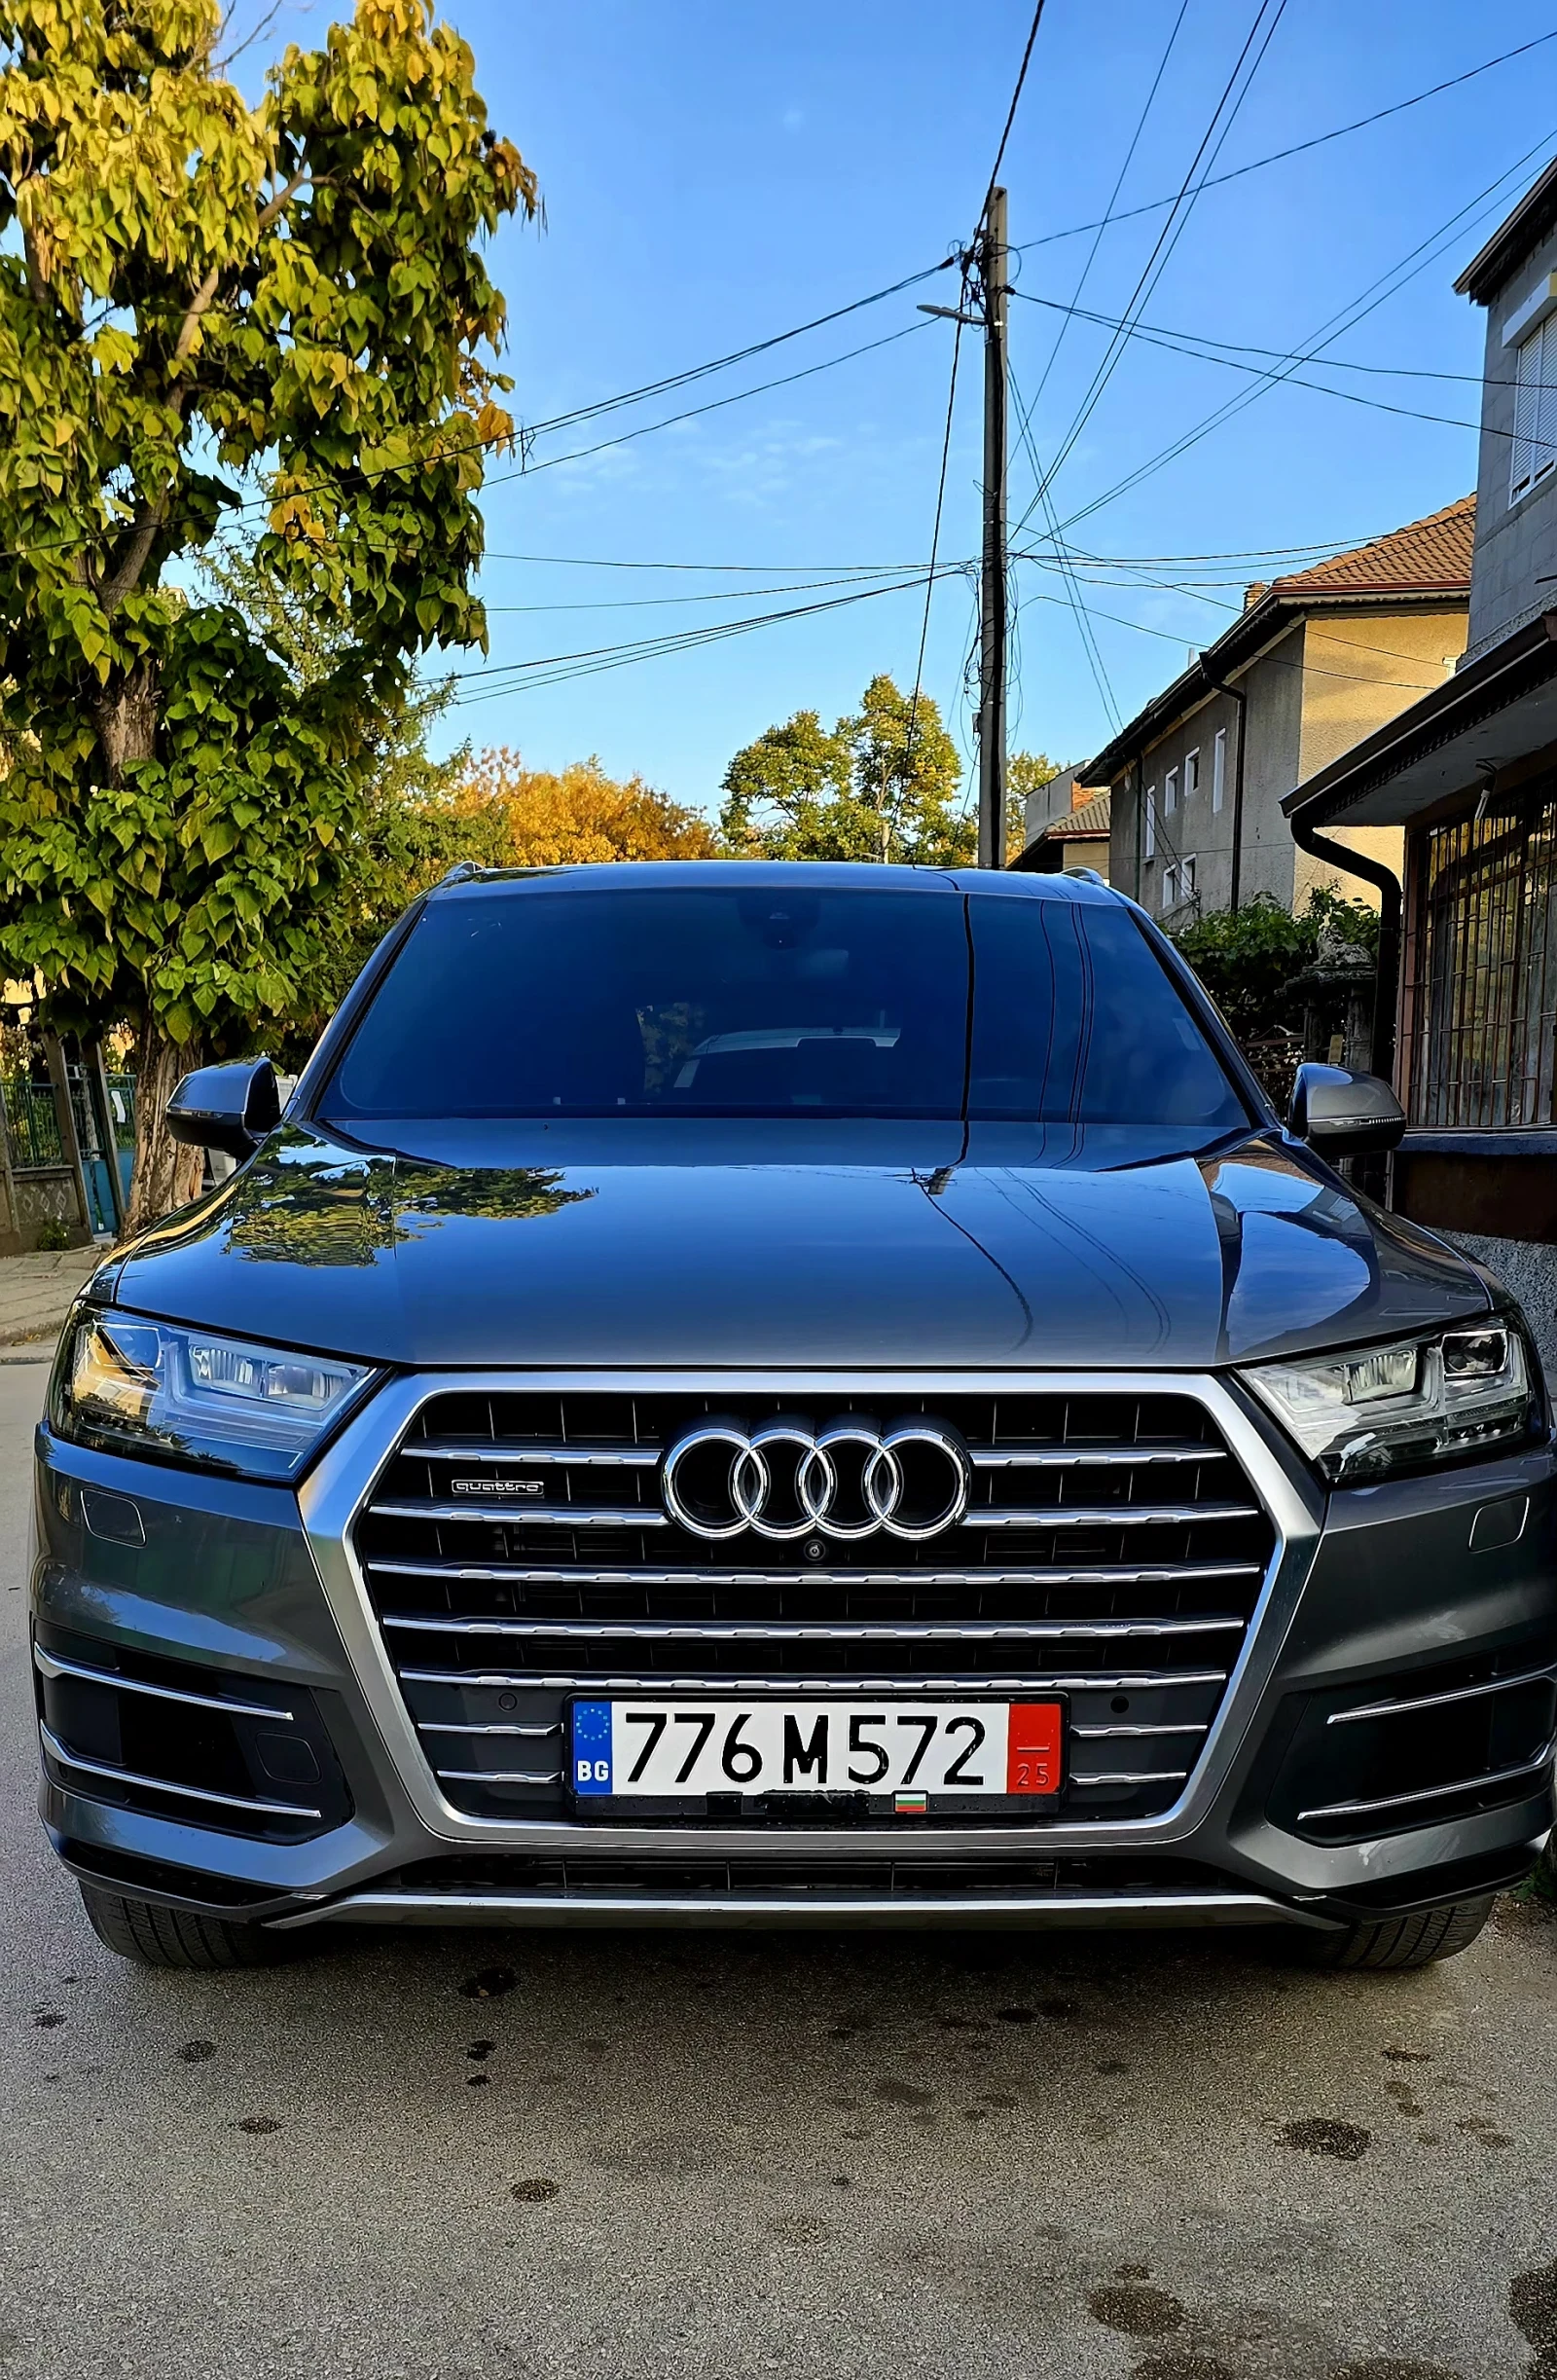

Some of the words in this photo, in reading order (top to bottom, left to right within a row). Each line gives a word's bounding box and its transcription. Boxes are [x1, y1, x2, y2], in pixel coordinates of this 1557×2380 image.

[455, 1483, 539, 1491] quattro
[626, 1712, 763, 1783] 776
[782, 1714, 829, 1784] M
[848, 1714, 986, 1785] 572
[577, 1760, 609, 1782] BG
[1016, 1763, 1049, 1786] 25
